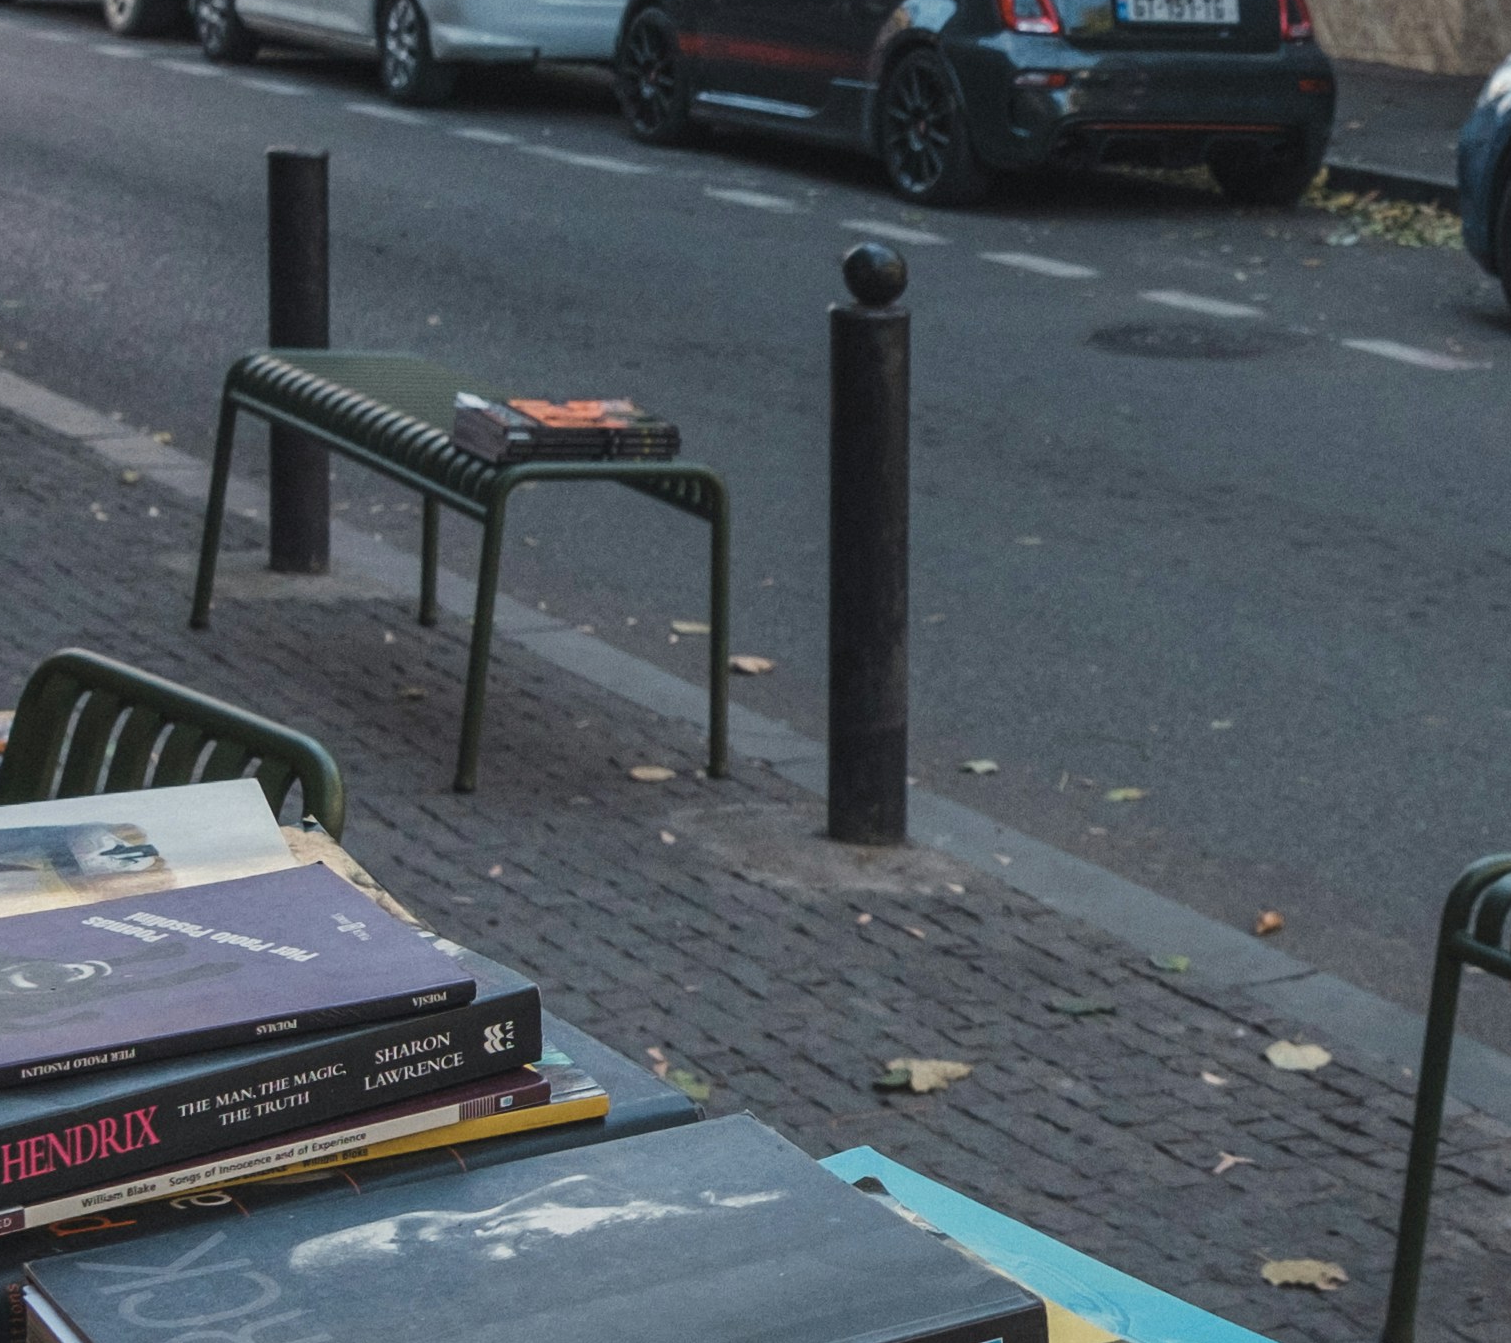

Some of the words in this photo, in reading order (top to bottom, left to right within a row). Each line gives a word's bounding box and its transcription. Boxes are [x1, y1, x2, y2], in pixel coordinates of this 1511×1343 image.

[20, 1059, 71, 1079] PASOLINI
[255, 1018, 298, 1036] POEMAS
[374, 1031, 451, 1066] SHARON
[504, 1019, 515, 1050] PAN
[178, 1097, 211, 1119] THE
[258, 1080, 291, 1100] THE
[293, 1064, 348, 1091] MAGIC,
[363, 1051, 464, 1091] LAWRENCE
[218, 1107, 250, 1127] THE
[254, 1091, 311, 1122] TRUTH
[0, 1106, 160, 1184] HENDRIX
[80, 1187, 123, 1210] William
[125, 1181, 157, 1199] Blake
[169, 1172, 201, 1188] Songs
[204, 1168, 217, 1180] of
[219, 1155, 272, 1176] Innocence
[274, 1149, 295, 1162] and
[311, 1131, 367, 1153] Experience
